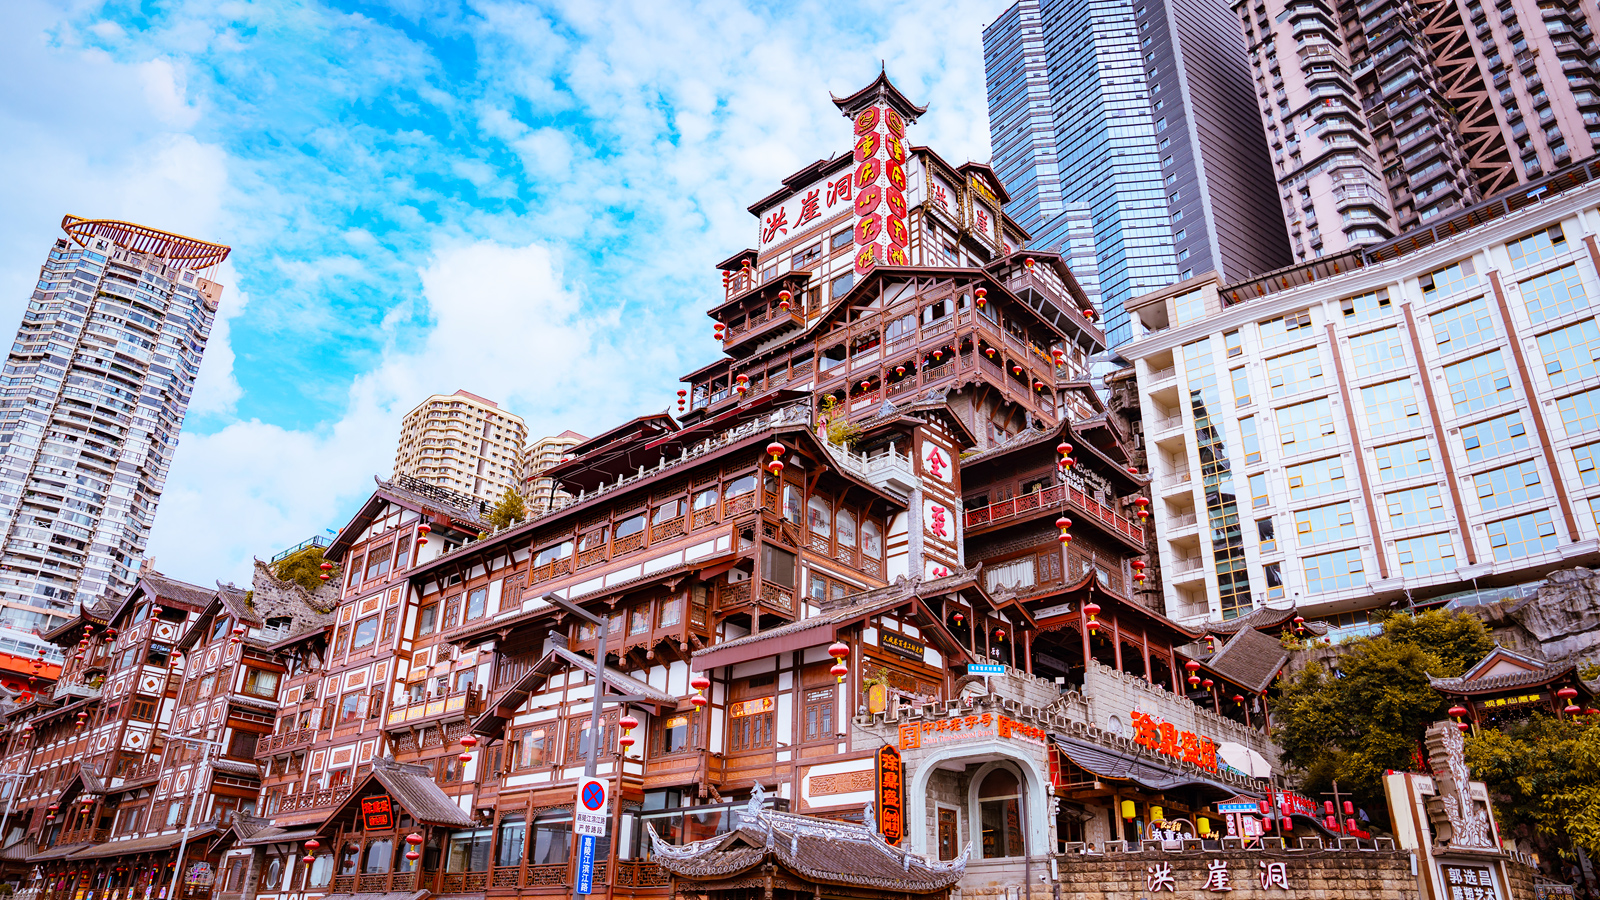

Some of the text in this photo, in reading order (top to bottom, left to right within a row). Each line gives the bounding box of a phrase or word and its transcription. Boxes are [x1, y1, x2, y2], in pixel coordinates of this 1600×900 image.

[762, 173, 853, 244] 洪崖洞
[922, 713, 994, 735] 中华老字号
[922, 729, 994, 745] China Time-honored Brand
[580, 837, 592, 892] 嘉陵江滨江路
[1147, 859, 1289, 892] 洪崖洞
[1448, 867, 1493, 887] 郭选昌
